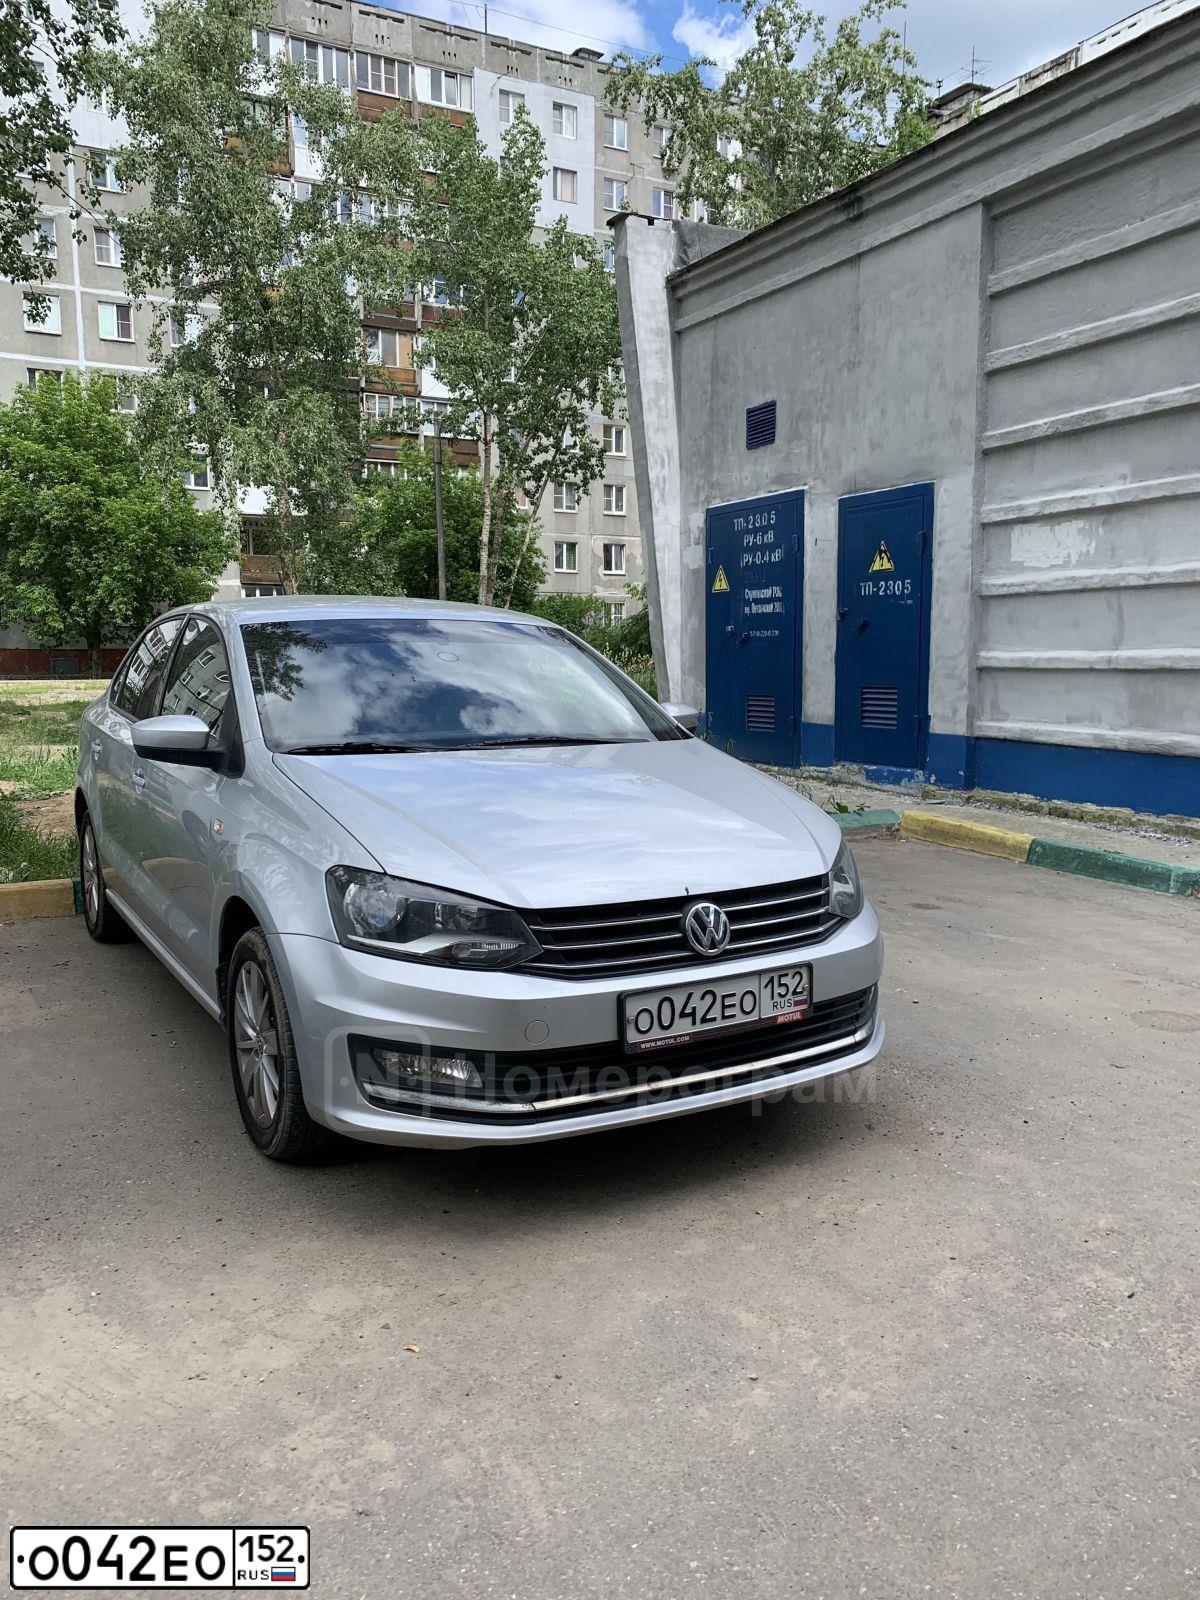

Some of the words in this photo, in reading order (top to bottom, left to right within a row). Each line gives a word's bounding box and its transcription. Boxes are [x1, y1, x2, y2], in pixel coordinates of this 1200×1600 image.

[859, 579, 911, 596] ТП-2305
[763, 971, 804, 1001] 152
[772, 999, 793, 1011] RUS
[777, 1012, 802, 1025] MOTUL
[640, 1035, 690, 1049] WWW.MOTUL.COM
